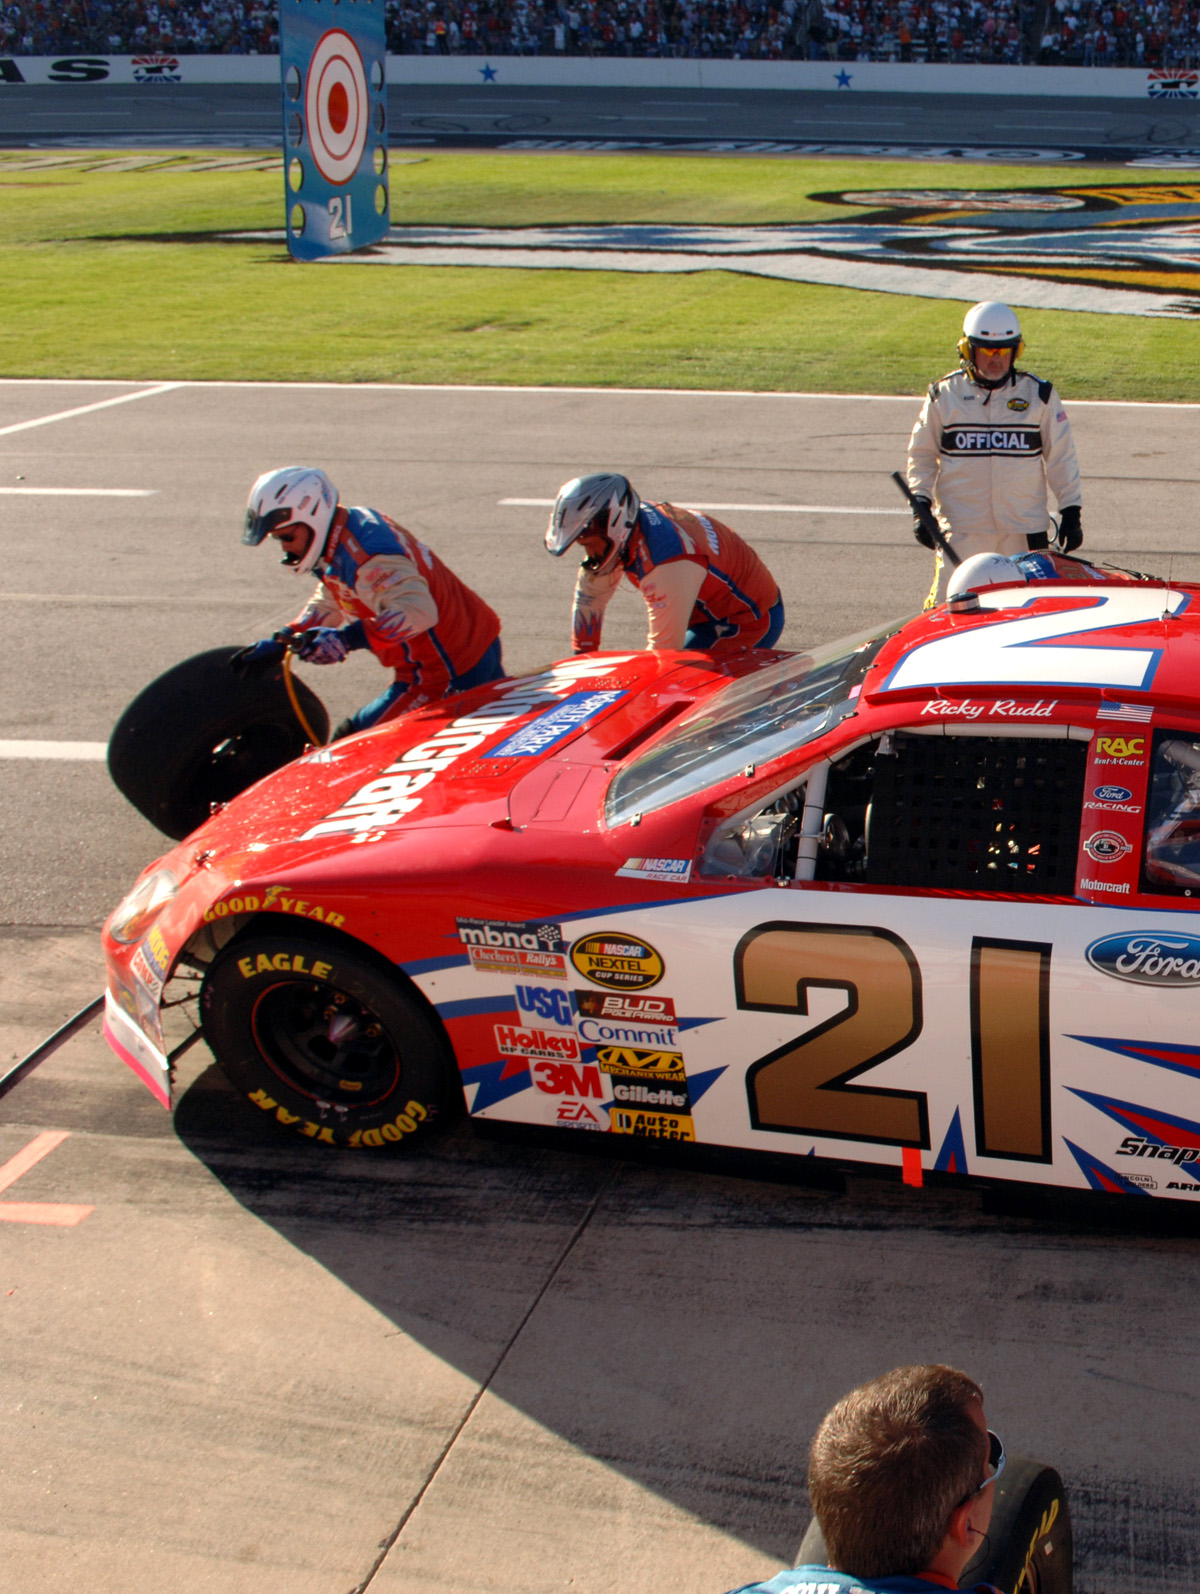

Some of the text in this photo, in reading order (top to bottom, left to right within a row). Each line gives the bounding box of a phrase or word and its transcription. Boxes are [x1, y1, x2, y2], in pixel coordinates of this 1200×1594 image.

[329, 194, 352, 240] 21
[955, 431, 1029, 450] OFFICIAL
[921, 699, 1059, 719] Ricky Rudd
[298, 654, 638, 843] Motorcraft
[510, 724, 573, 756] PARK
[1096, 737, 1145, 757] RAC
[1099, 787, 1125, 799] Ford
[1083, 801, 1142, 814] RACING
[642, 858, 686, 873] NASCAR
[1080, 878, 1131, 895] Motorcraft
[458, 926, 539, 950] mbna
[472, 949, 557, 966] Checkers Rally's
[603, 942, 643, 957] NASCAR
[238, 953, 332, 980] EAGLE
[588, 956, 647, 972] NEXTEL
[595, 971, 644, 983] CUP SERIES
[515, 985, 573, 1027] USG
[603, 996, 666, 1012] BUD
[496, 1026, 577, 1059] Holley
[578, 1020, 678, 1046] Commit
[733, 919, 1053, 1164] 21
[499, 1046, 565, 1059] HP CARBS
[533, 1061, 604, 1099] 3M
[614, 1085, 687, 1107] Gillette
[557, 1101, 598, 1123] EA
[635, 1114, 679, 1129] Auto
[556, 1121, 601, 1131] SPORTS
[634, 1125, 690, 1141] Meter
